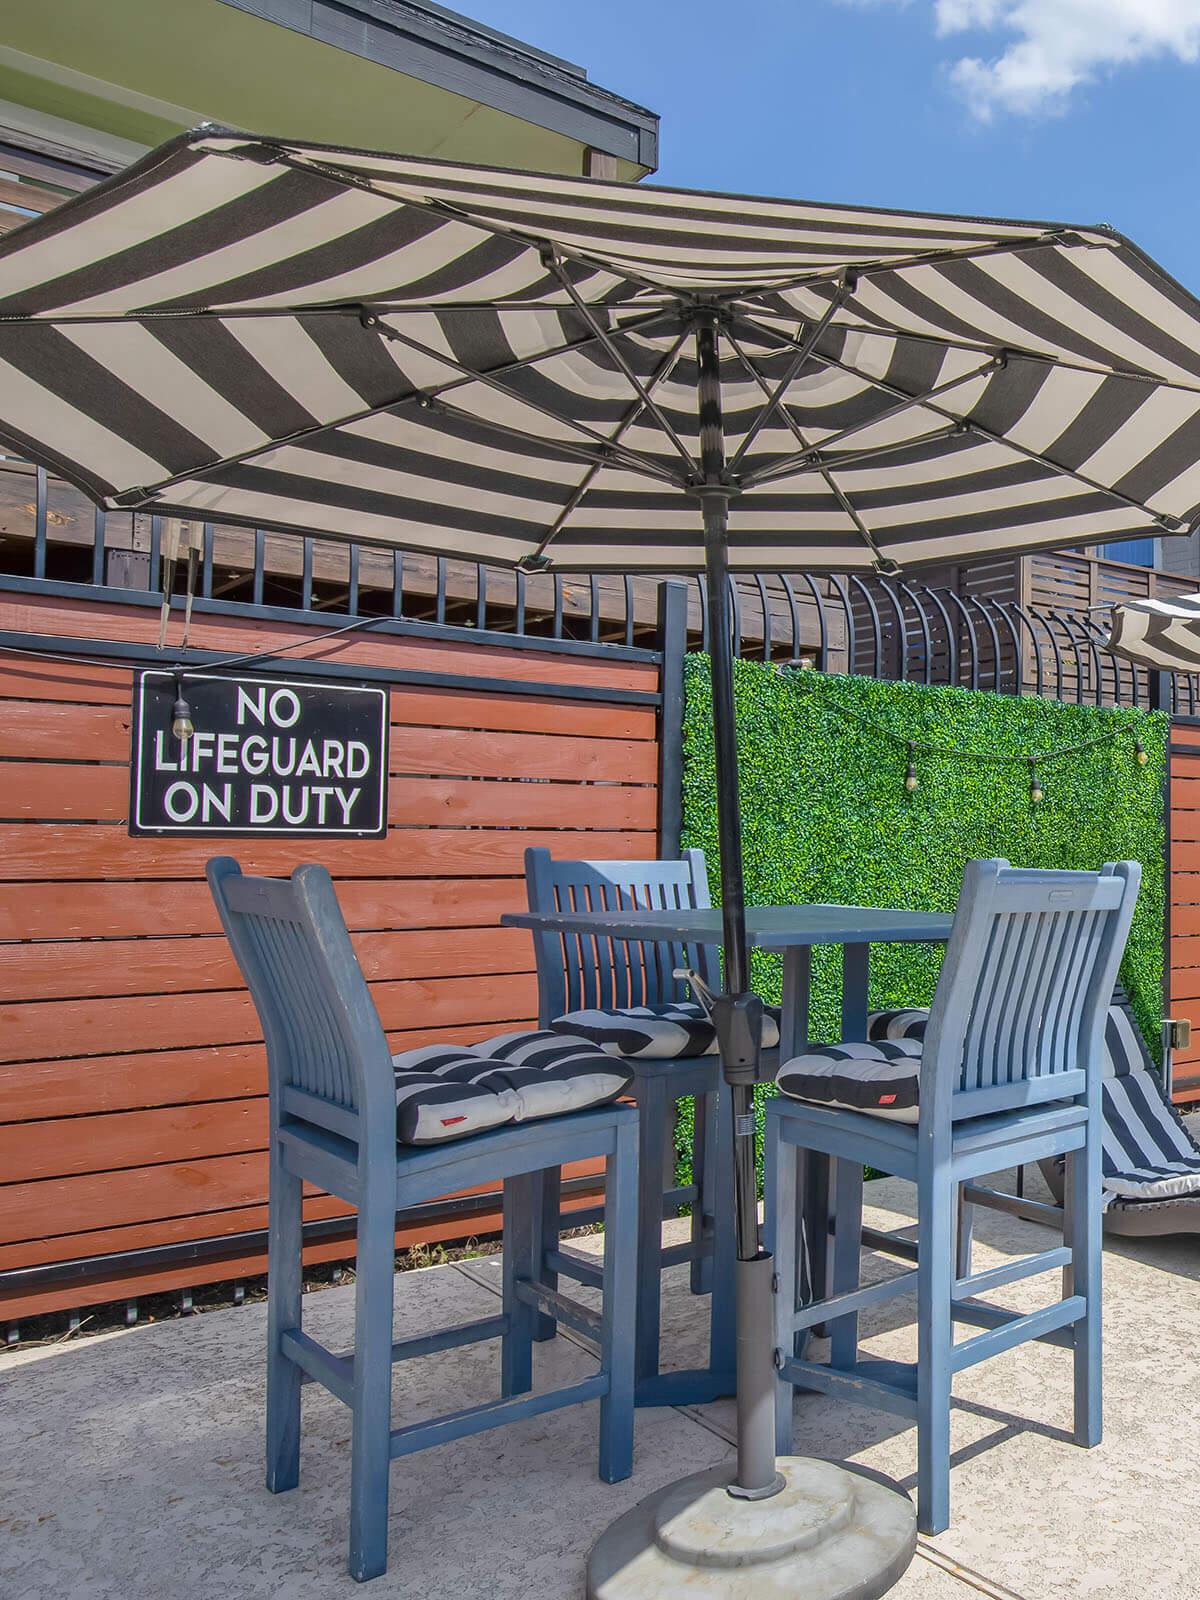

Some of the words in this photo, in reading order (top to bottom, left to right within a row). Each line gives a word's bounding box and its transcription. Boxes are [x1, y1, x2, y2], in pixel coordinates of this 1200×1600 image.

[237, 686, 300, 728] NO
[155, 730, 370, 778] LIFEGUARD
[164, 781, 232, 823] ON
[250, 784, 360, 825] DUTY
